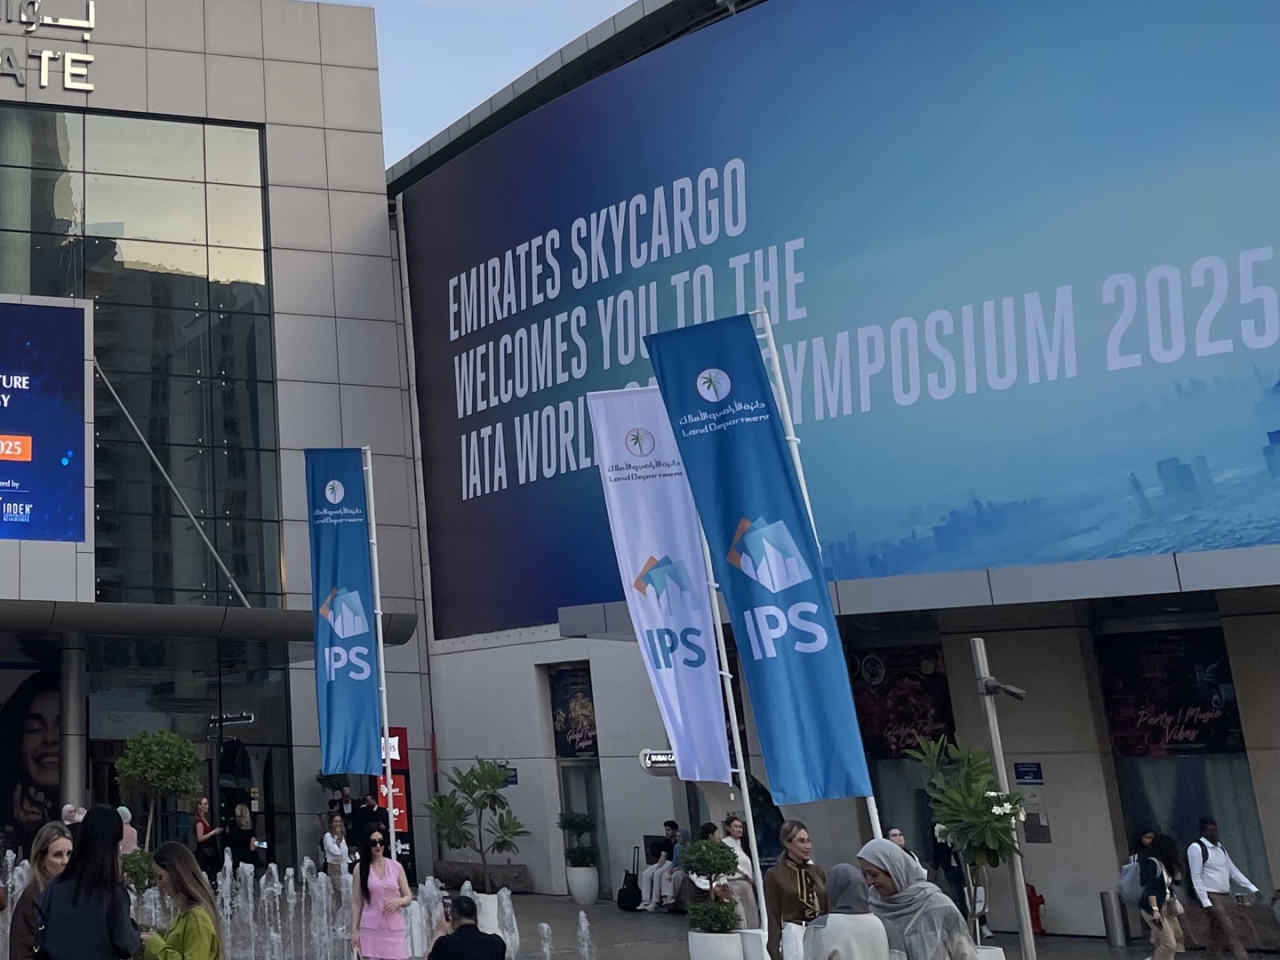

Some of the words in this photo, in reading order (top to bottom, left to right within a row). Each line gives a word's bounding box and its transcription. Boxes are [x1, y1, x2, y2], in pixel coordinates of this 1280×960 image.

[448, 229, 562, 342] EMIRATES
[570, 157, 748, 290] SKYCARGO
[453, 304, 589, 420] WELCOMES
[596, 280, 659, 371] YOU
[671, 264, 715, 329] TO
[729, 238, 808, 321] THE
[460, 422, 508, 501] IATA
[514, 396, 600, 486] WORL
[1101, 245, 1280, 372] 2025
[682, 425, 709, 438] Land
[709, 414, 771, 432] Department
[11, 480, 20, 489] by
[608, 473, 631, 483] Land
[631, 471, 683, 482] Department
[2, 502, 31, 515] INDEX
[743, 601, 829, 662] IPS
[324, 645, 372, 682] IPS
[645, 626, 707, 671] IPS
[1136, 710, 1175, 729] Party
[1184, 706, 1223, 724] Music
[1165, 724, 1200, 743] Vibes
